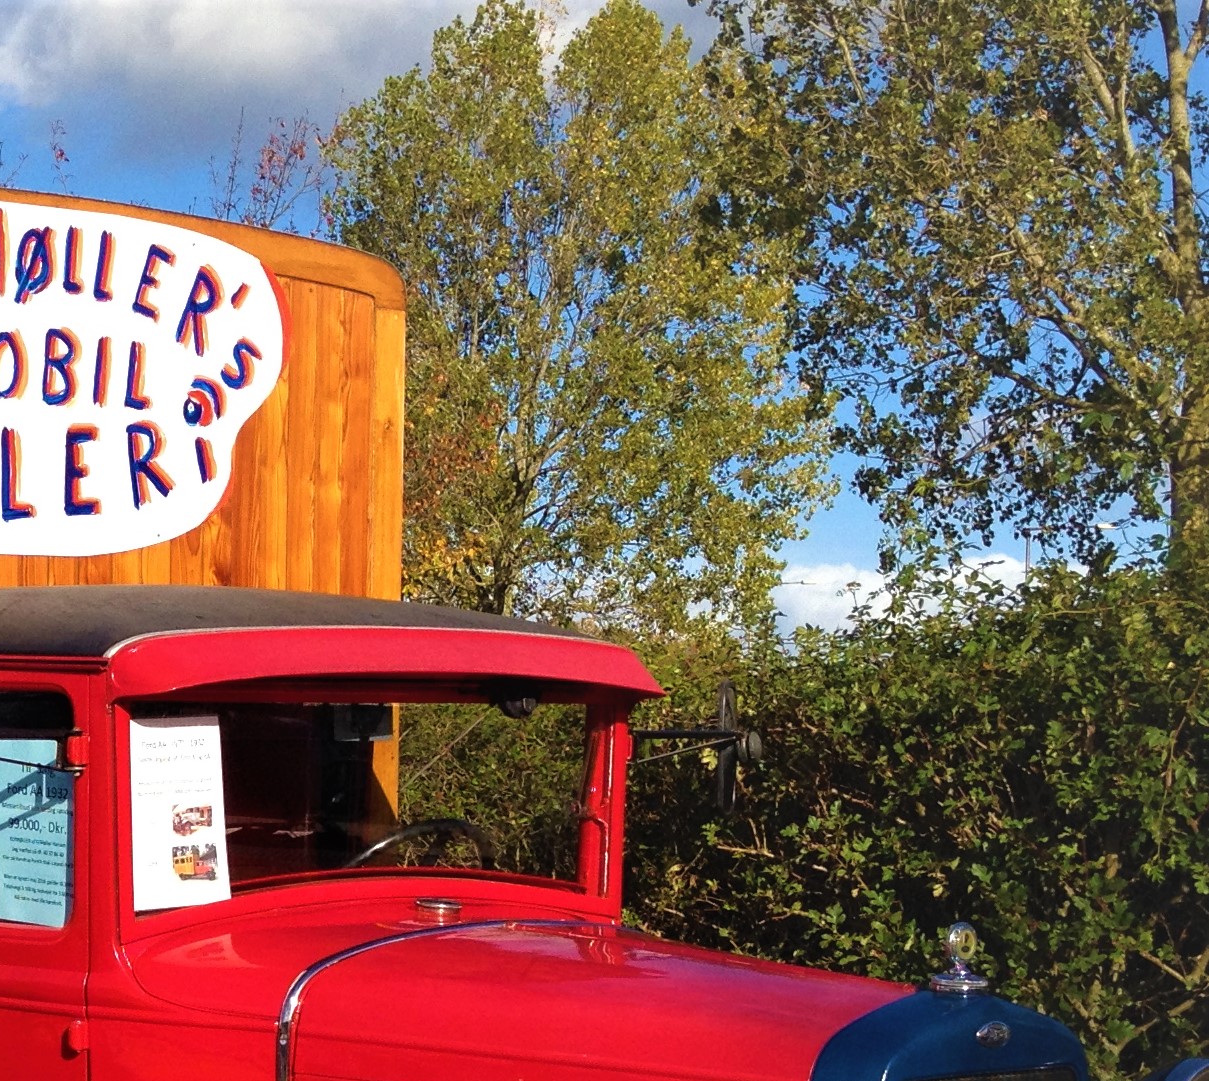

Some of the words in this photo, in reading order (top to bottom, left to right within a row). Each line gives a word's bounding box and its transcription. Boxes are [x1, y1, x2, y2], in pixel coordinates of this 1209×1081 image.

[7, 782, 28, 796] Ford
[29, 784, 44, 797] AA
[46, 786, 69, 799] 1932
